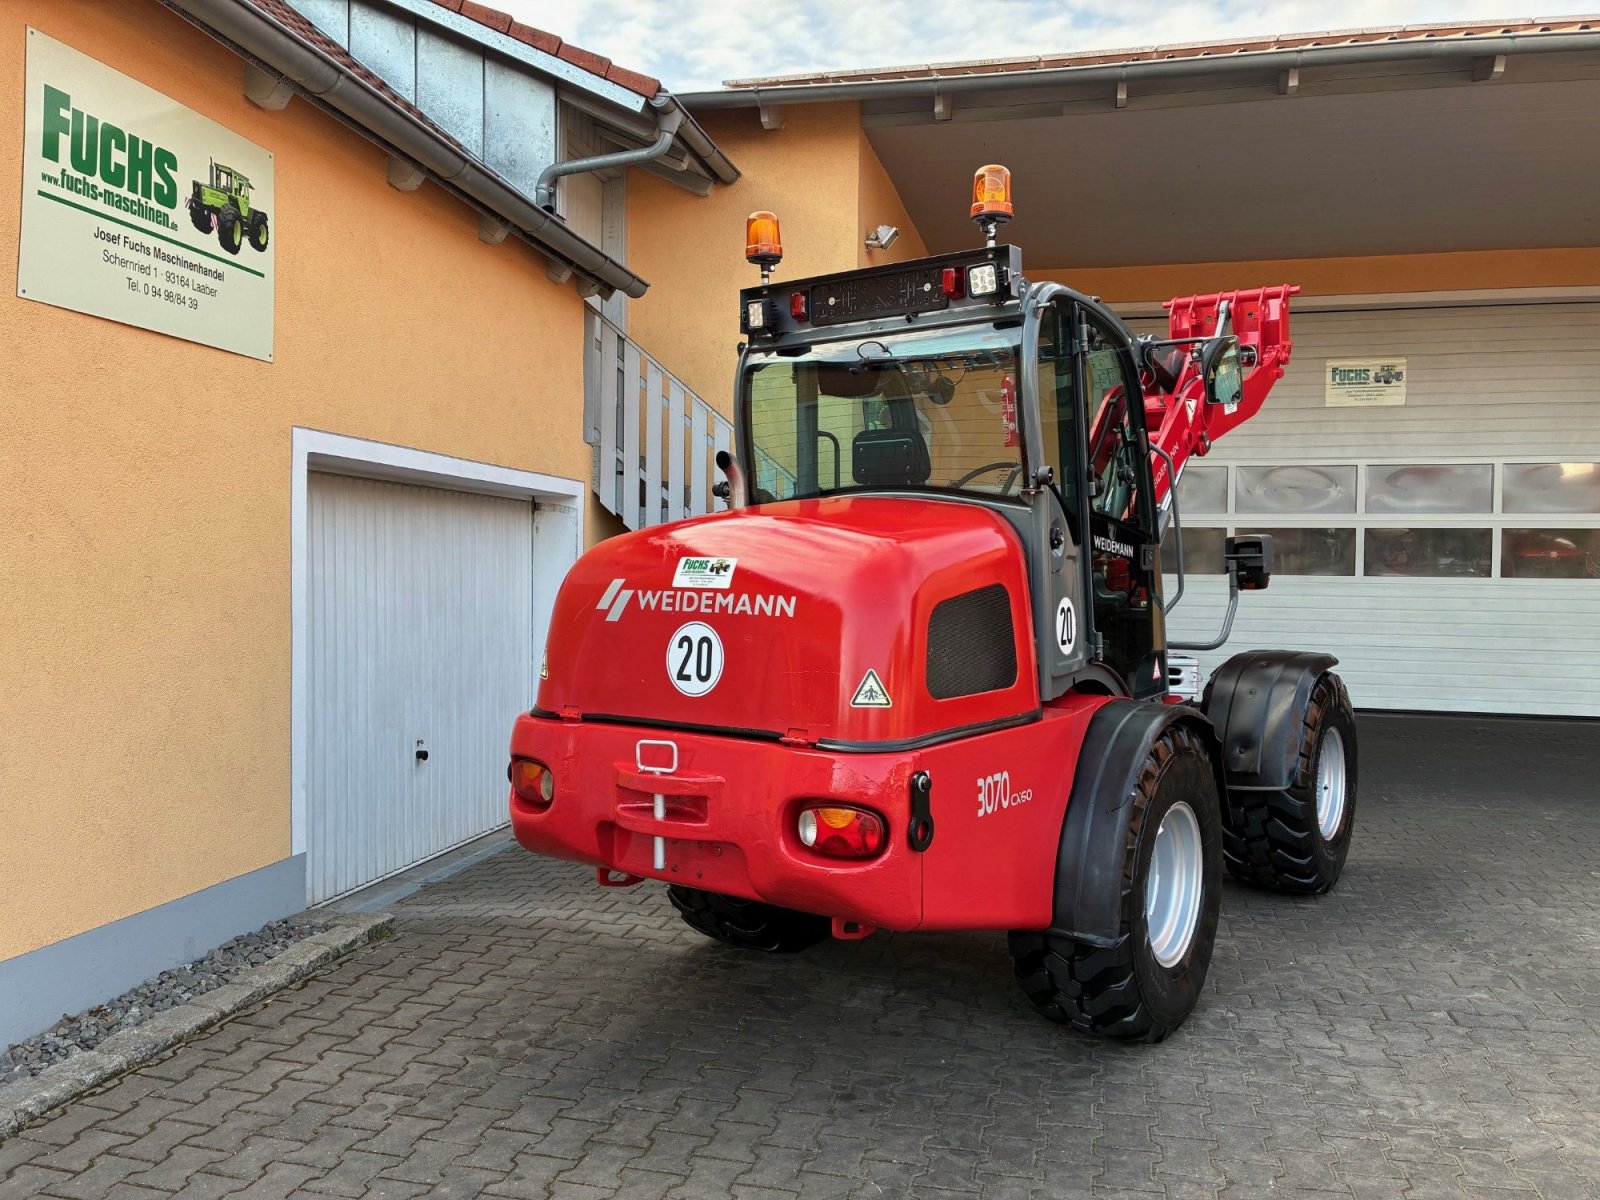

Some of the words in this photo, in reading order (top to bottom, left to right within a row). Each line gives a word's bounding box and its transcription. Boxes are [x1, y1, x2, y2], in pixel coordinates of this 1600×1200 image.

[42, 83, 178, 210] FUCHS
[41, 168, 179, 231] www.fuchs-maschinen.de
[94, 226, 121, 246] Josef
[123, 235, 151, 257] Fuchs
[153, 246, 225, 282] Maschinenhandel
[102, 249, 151, 276] Schernried
[154, 267, 158, 278] 1
[166, 270, 190, 288] 93164
[192, 279, 218, 298] Laaber
[126, 277, 141, 293] Tel.
[144, 283, 149, 296] 0
[152, 286, 162, 298] 94
[164, 289, 186, 307] 98/84
[188, 298, 198, 310] 39
[1331, 367, 1370, 382] FUCHS
[682, 558, 710, 570] FUCHS
[1093, 535, 1134, 558] WEIDEMANN
[638, 590, 796, 618] WEIDEMANN
[1059, 606, 1073, 646] 20
[676, 635, 713, 682] 20
[977, 770, 1010, 818] 3070
